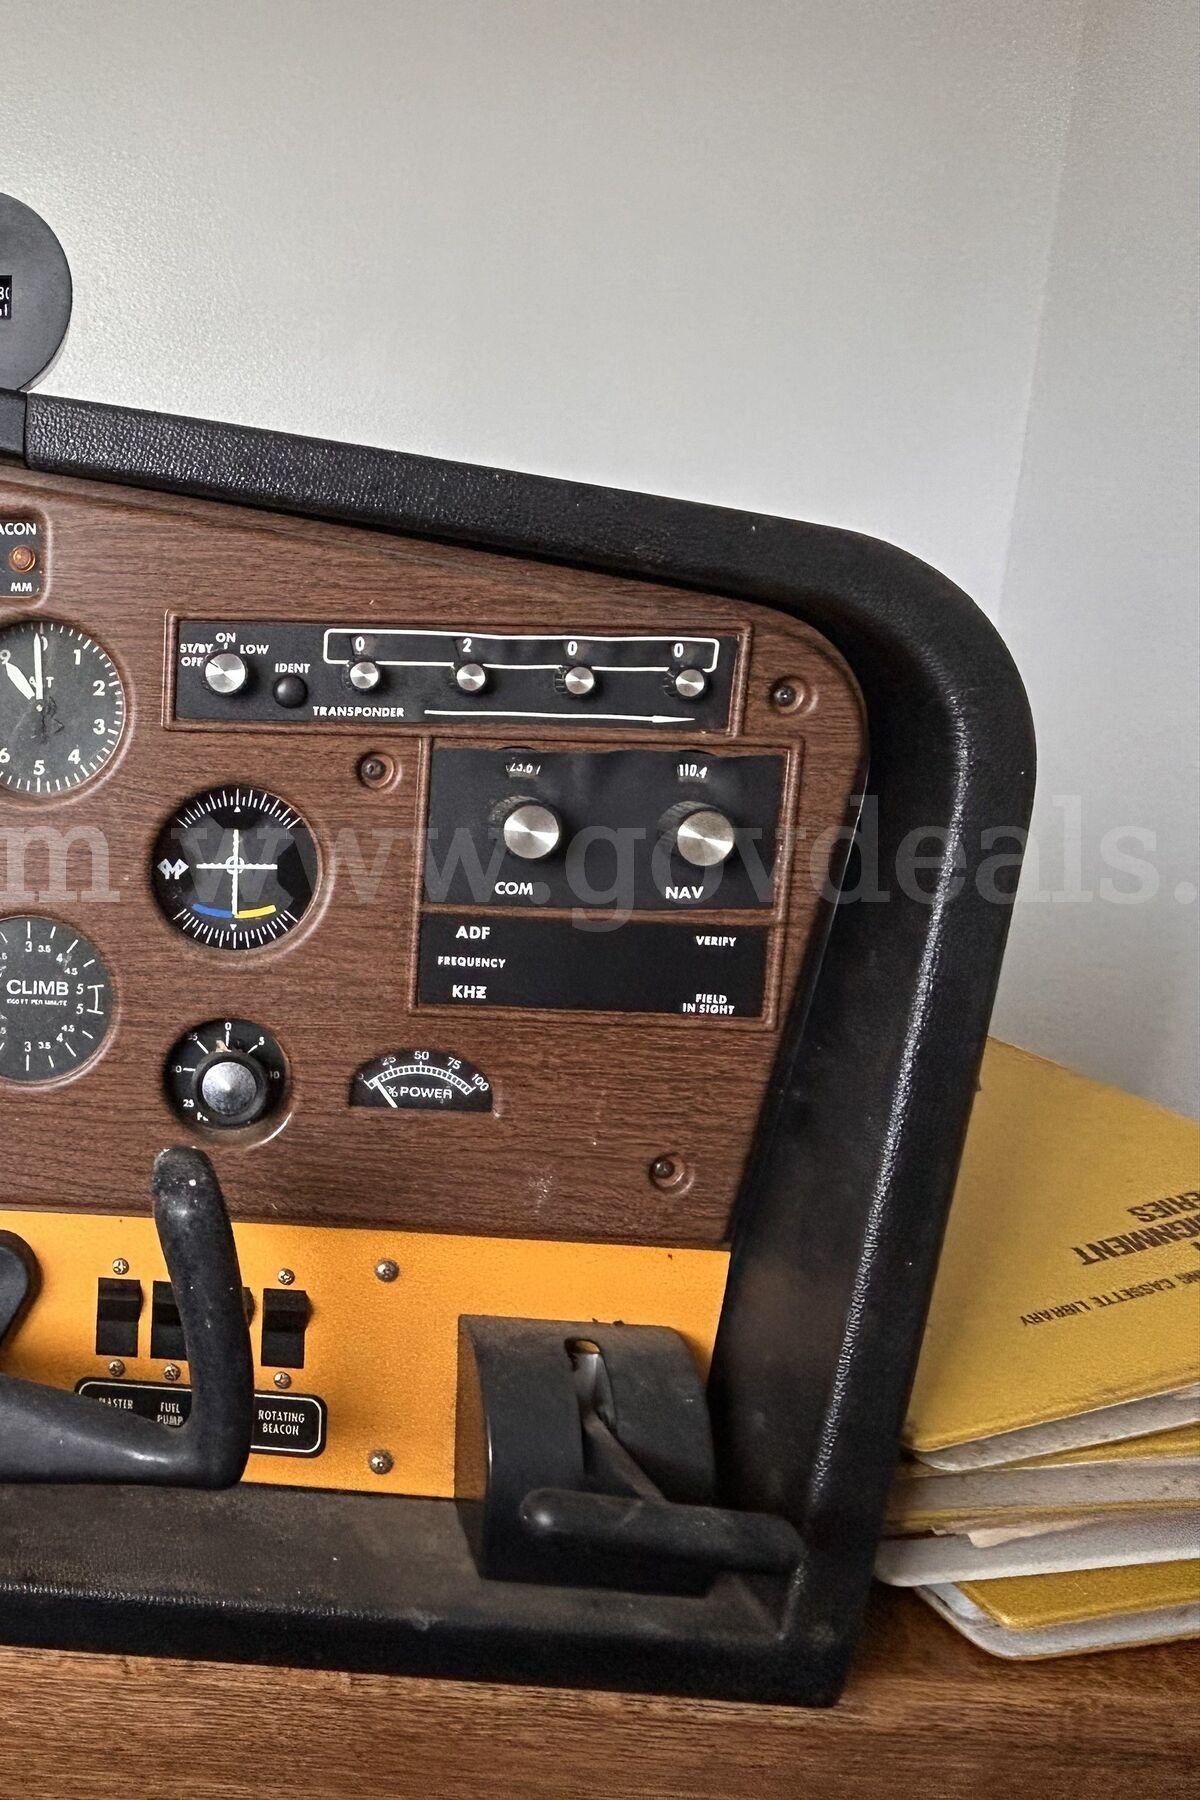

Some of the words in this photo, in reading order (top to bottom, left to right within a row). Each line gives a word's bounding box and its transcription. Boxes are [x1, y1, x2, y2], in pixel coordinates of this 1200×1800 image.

[10, 582, 33, 592] MM
[215, 632, 236, 643] ON
[179, 643, 213, 654] ST/BY
[240, 644, 269, 655] LOW
[355, 636, 365, 651] 0
[462, 638, 472, 653] 2
[567, 641, 578, 656] 0
[673, 643, 684, 658] 0
[73, 649, 82, 665] 1
[274, 663, 310, 674] IDENT
[92, 680, 106, 696] 2
[312, 705, 405, 718] TRANSPONDER
[92, 719, 106, 735] 3
[67, 749, 81, 764] 4
[33, 759, 45, 776] 5
[494, 882, 534, 896] COM
[665, 886, 704, 900] NAV
[455, 926, 491, 940] ADF
[25, 941, 33, 953] 3
[695, 936, 737, 947] VERIFY
[56, 953, 63, 962] 4
[437, 956, 506, 969] FREQUENCY
[6, 979, 69, 996] CLIMB
[76, 984, 84, 995] 5
[452, 985, 487, 999] KHZ
[695, 993, 728, 1005] FIELD
[76, 1004, 84, 1015] 5
[682, 1003, 696, 1013] IN
[699, 1003, 736, 1015] SIGHT
[224, 1022, 232, 1030] 0
[56, 1033, 64, 1042] 4
[258, 1036, 265, 1045] 5
[24, 1041, 32, 1052] 3
[38, 1041, 51, 1050] 3.5
[414, 1051, 430, 1061] 50
[447, 1057, 462, 1070] 75
[471, 1073, 490, 1092] 100
[183, 1098, 195, 1108] 25
[1090, 1278, 1176, 1308] CASSETTE
[1019, 1300, 1091, 1327] LIBRARY
[160, 1401, 180, 1414] FUEL
[157, 1414, 184, 1426] PUMP
[258, 1410, 305, 1424] ROTATING
[262, 1422, 300, 1436] BEACON
